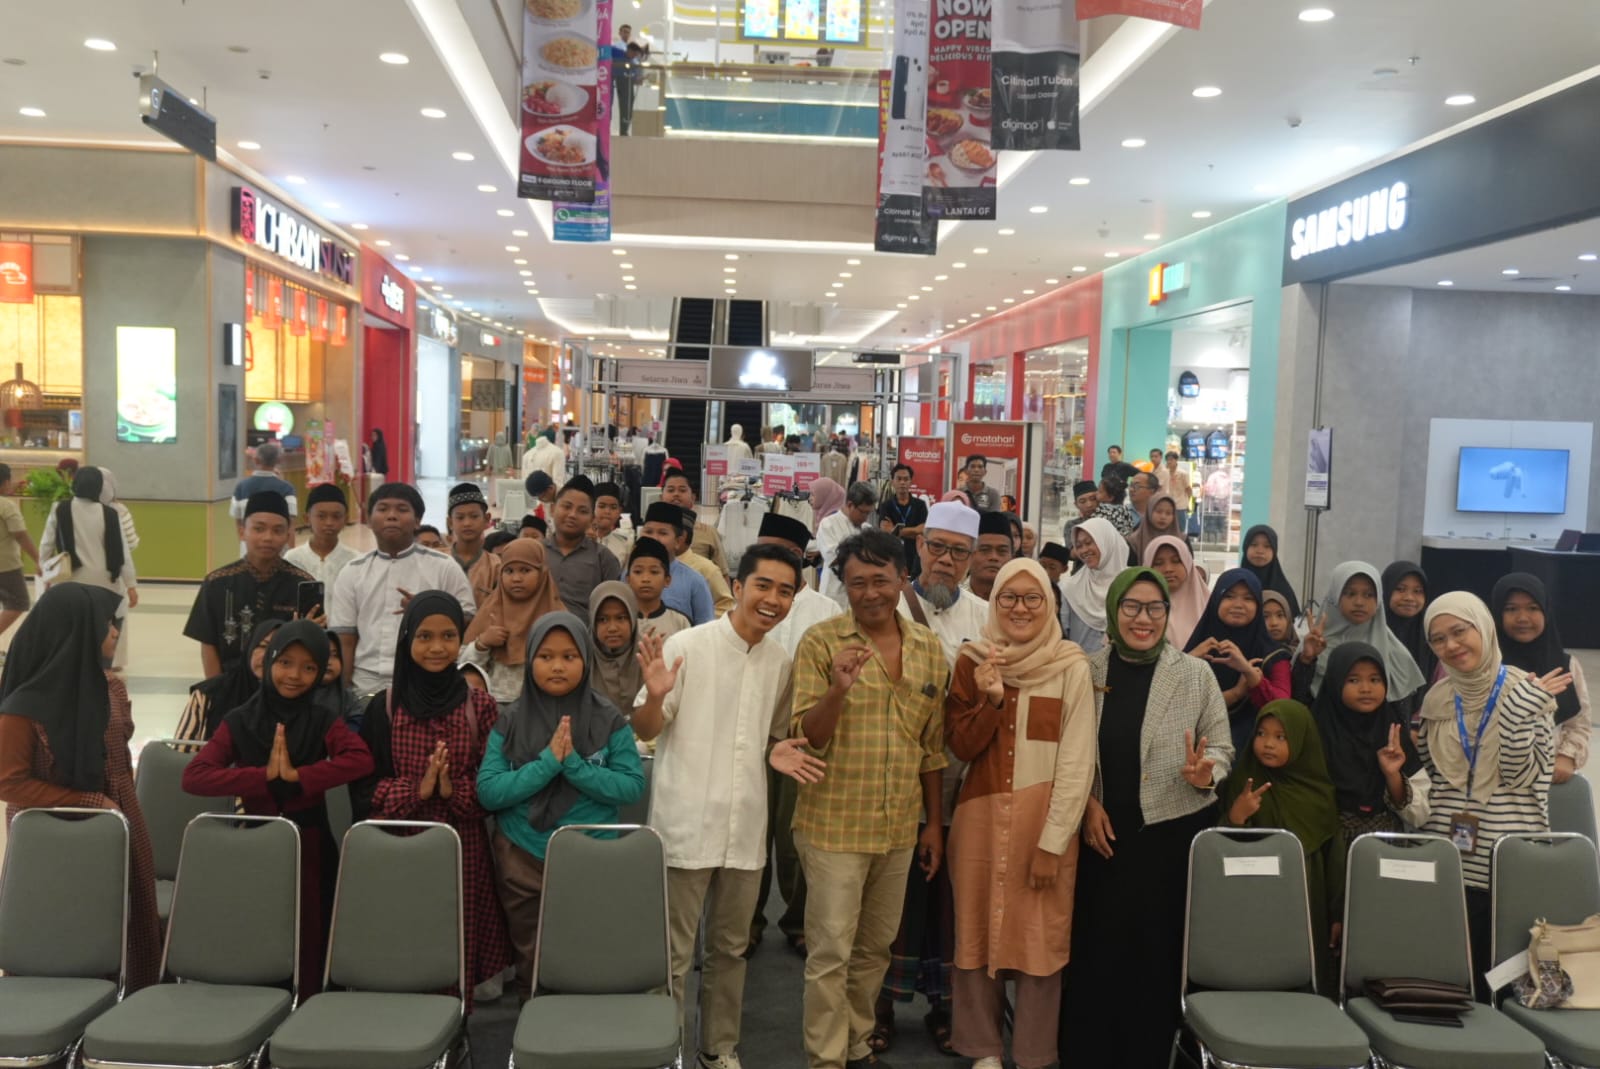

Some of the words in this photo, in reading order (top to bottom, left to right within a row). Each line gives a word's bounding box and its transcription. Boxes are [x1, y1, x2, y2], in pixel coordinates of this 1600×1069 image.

[937, 0, 992, 16] NOW
[934, 19, 992, 39] OPEN
[934, 44, 962, 54] HAPPY
[930, 53, 973, 62] DELICIOUS
[1001, 75, 1040, 88] Citimall
[1043, 74, 1073, 87] Tuban
[945, 207, 977, 216] LANTAI
[979, 207, 991, 216] GF
[1290, 181, 1407, 260] SAMSUNG
[972, 433, 1015, 444] matahari
[912, 450, 941, 460] matahari
